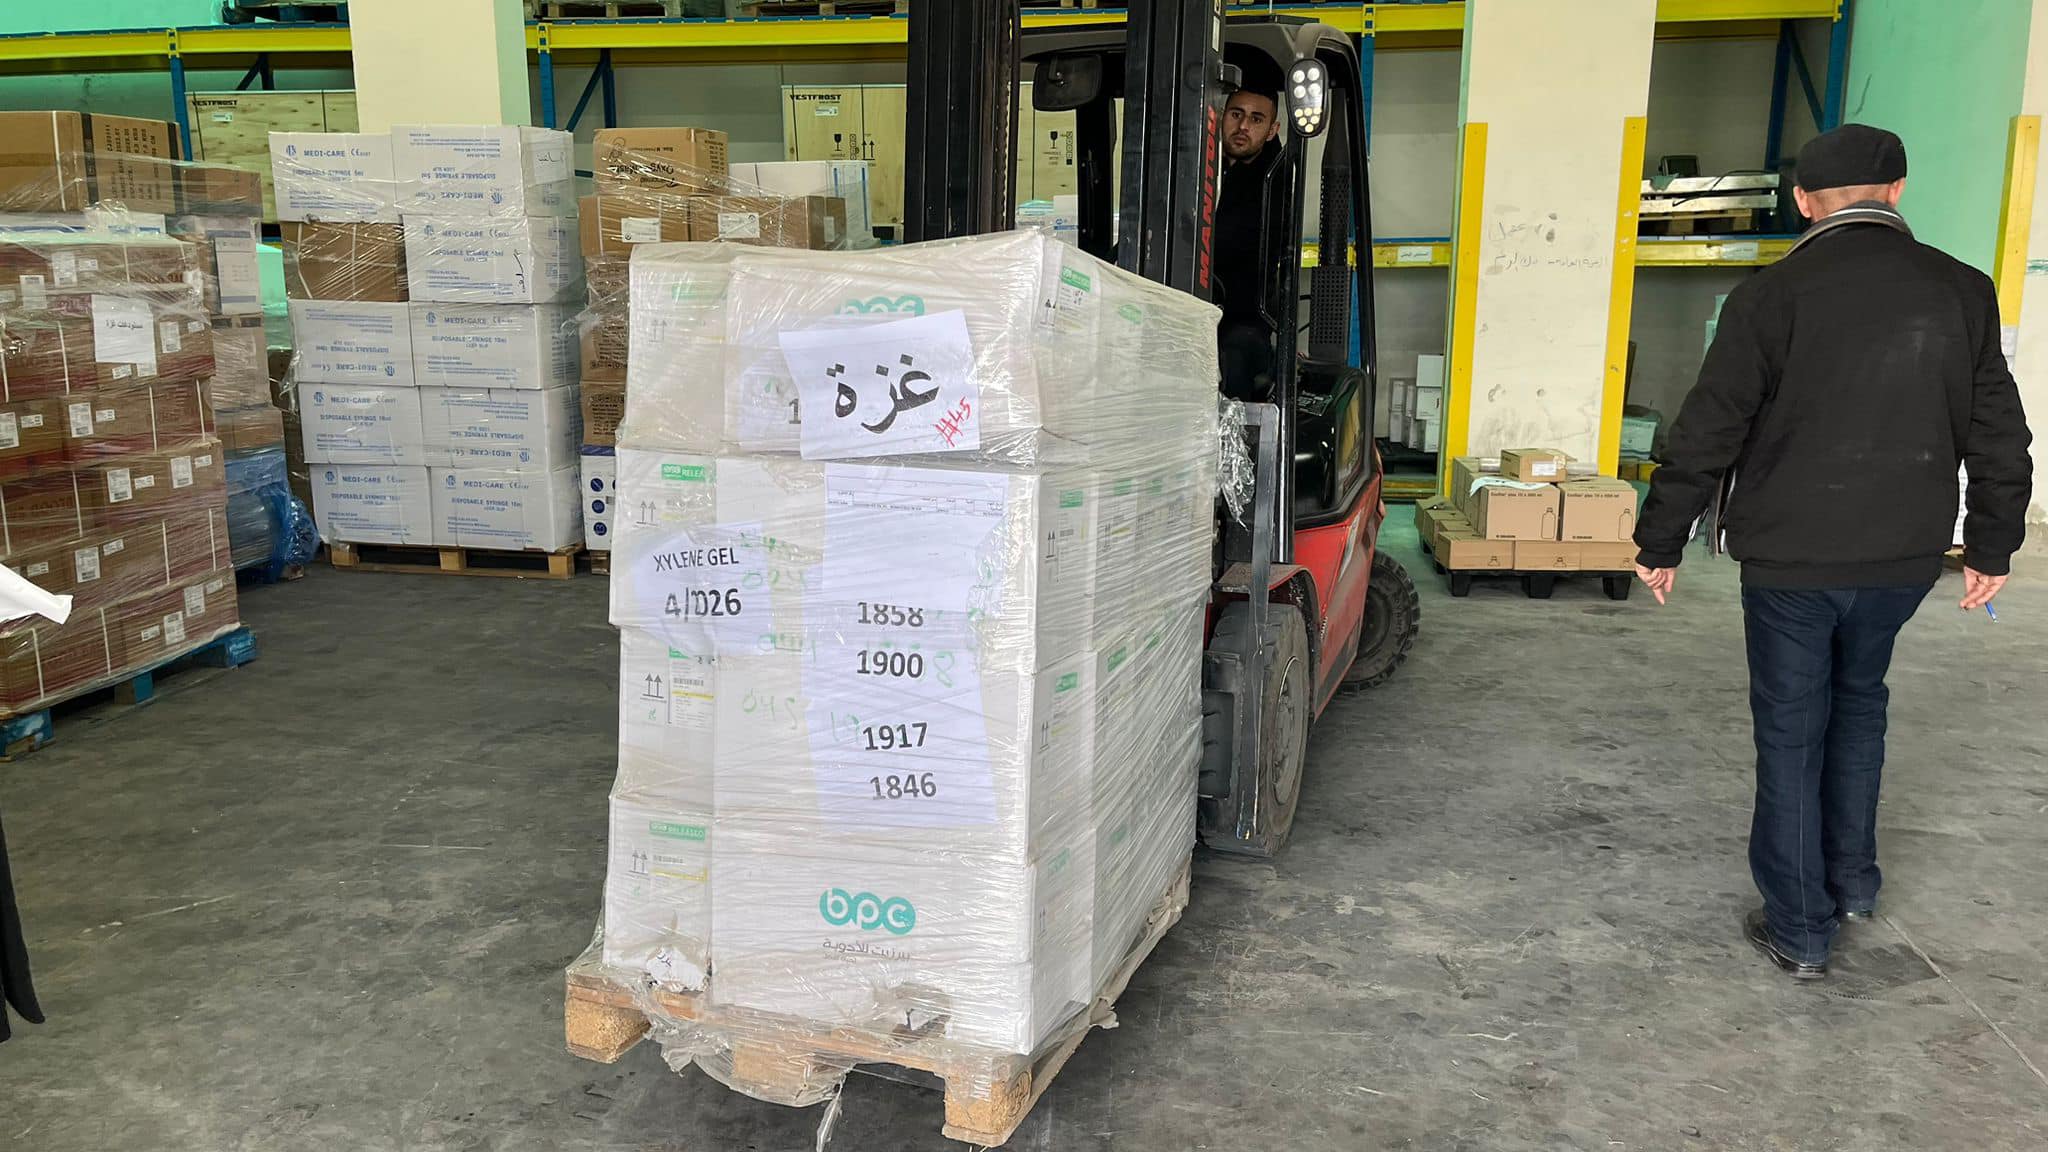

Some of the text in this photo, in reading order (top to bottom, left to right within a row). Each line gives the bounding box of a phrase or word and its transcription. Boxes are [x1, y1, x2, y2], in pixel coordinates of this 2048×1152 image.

[192, 99, 238, 107] VESTFROST
[441, 191, 484, 199] MEDI-CARE
[1200, 105, 1217, 288] MANITOU
[445, 317, 487, 325] MEDI-CARE
[336, 363, 377, 371] MEDI-CARE
[331, 396, 371, 404] MEDI-CARE
[826, 354, 940, 434] غزة
[470, 449, 512, 457] MEDI-CARE
[343, 476, 382, 484] MEDI-CARE
[463, 480, 505, 489] MEDI-CARE
[653, 547, 739, 572] XYLENE GEL
[857, 601, 924, 628] 1858
[856, 650, 923, 679] 1900
[862, 721, 929, 751] 1917
[869, 772, 937, 801] 1846
[819, 887, 917, 935] bpc
